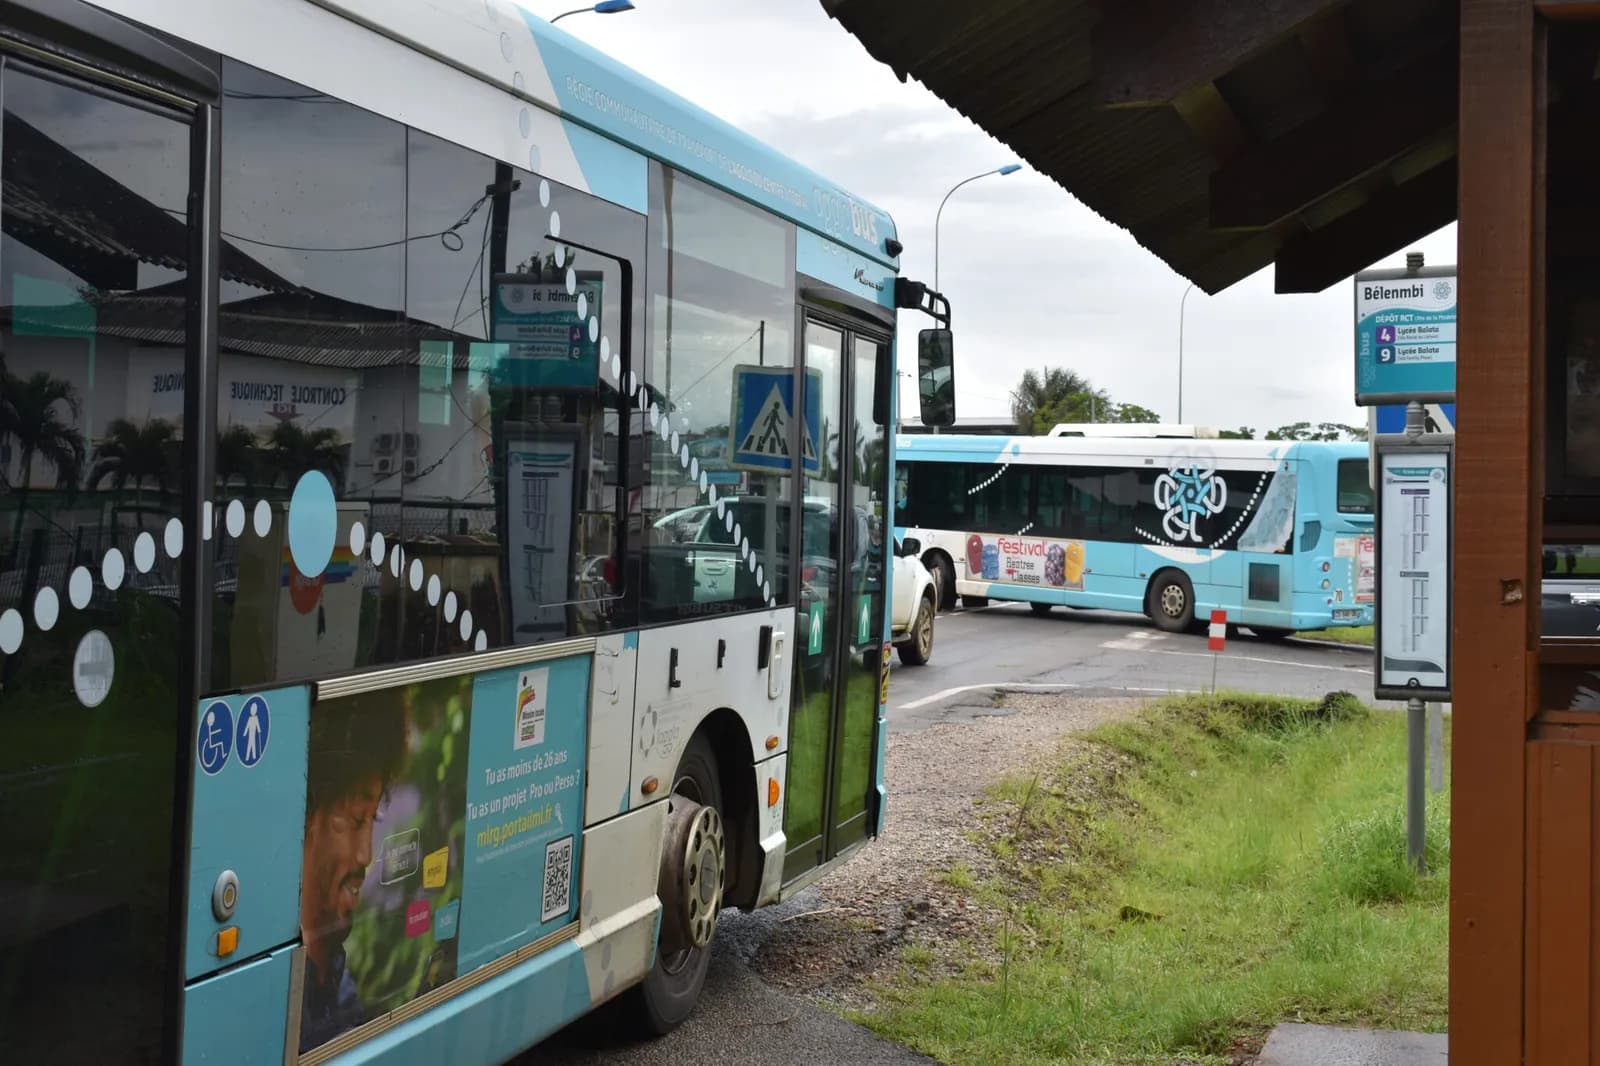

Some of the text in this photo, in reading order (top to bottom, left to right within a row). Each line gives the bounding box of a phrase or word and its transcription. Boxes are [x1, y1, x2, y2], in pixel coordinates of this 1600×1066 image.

[850, 200, 878, 246] bus
[1364, 284, 1424, 301] Bélenmbi
[1380, 328, 1391, 342] 4
[1398, 327, 1416, 336] Lycée
[1380, 348, 1391, 362] 9
[1398, 347, 1416, 355] Lycée
[1335, 590, 1343, 602] 70
[485, 750, 567, 786] Tu as moins de 26 ans
[467, 803, 477, 821] Tu
[479, 804, 488, 817] as
[490, 799, 501, 814] un
[502, 788, 526, 814] projet
[530, 783, 542, 800] Pro
[544, 780, 553, 795] ou
[554, 774, 574, 793] Perso
